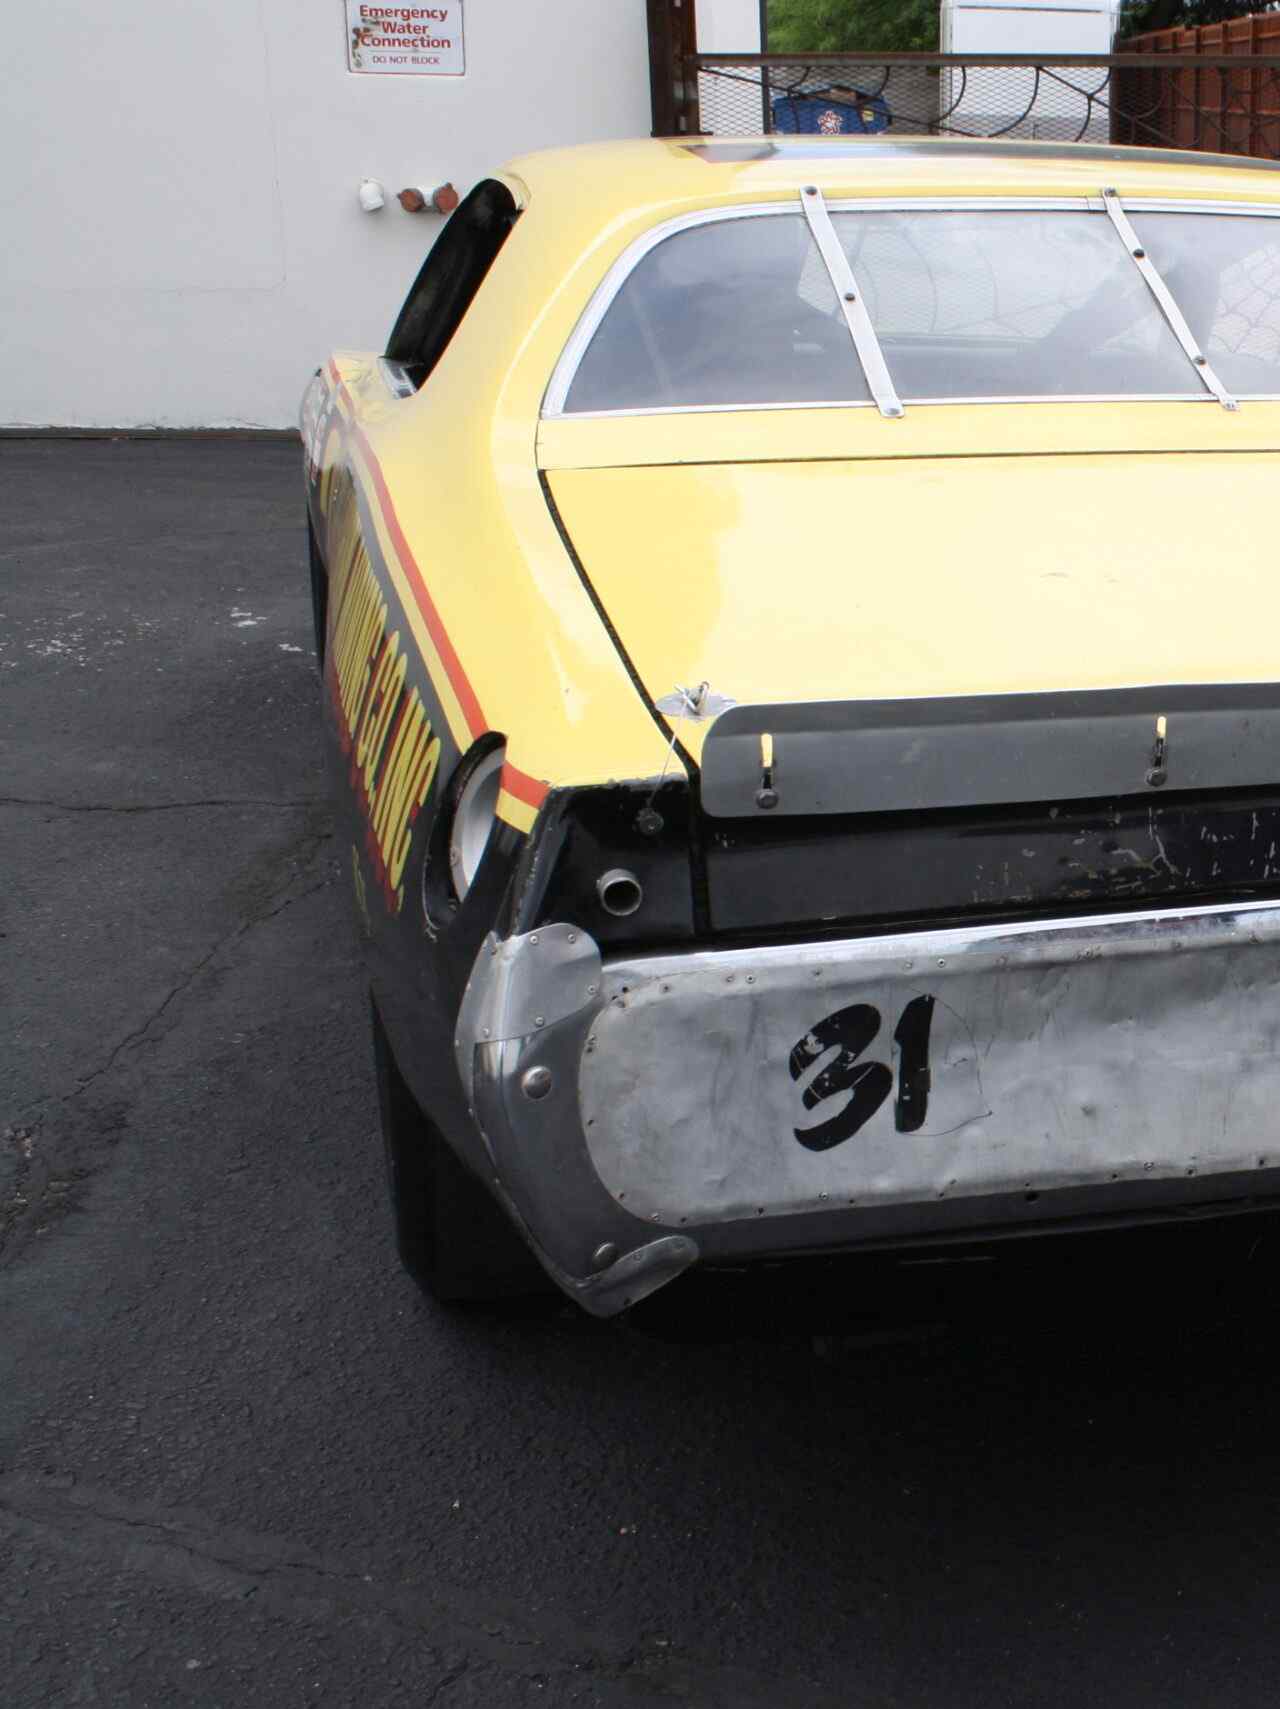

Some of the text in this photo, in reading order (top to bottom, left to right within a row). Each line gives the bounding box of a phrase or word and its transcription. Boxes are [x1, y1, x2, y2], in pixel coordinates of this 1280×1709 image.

[359, 5, 448, 22] Emergency
[382, 21, 429, 35] Water
[360, 35, 451, 48] Connection
[372, 55, 441, 65] DO NOT BLOCK
[789, 993, 935, 1152] 31
